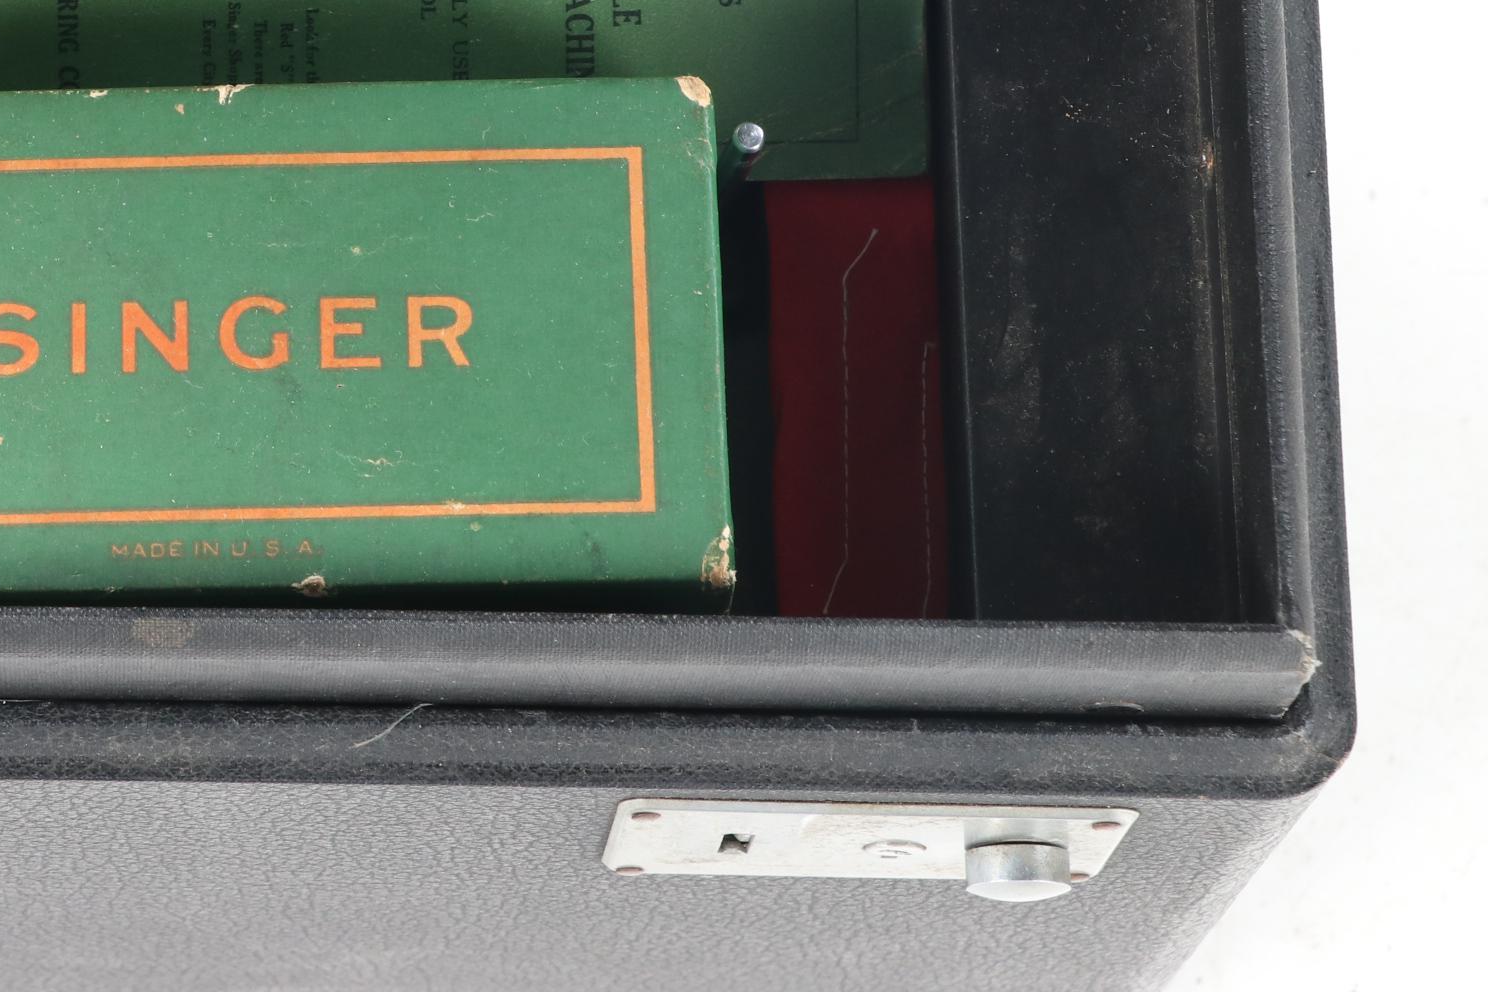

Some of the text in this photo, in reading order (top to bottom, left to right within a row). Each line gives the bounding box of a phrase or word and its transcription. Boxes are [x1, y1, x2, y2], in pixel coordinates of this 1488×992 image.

[201, 19, 217, 57] Every
[254, 19, 268, 58] There
[280, 23, 294, 48] Red
[451, 40, 471, 82] USE
[112, 542, 183, 559] MADE
[193, 542, 220, 557] IN
